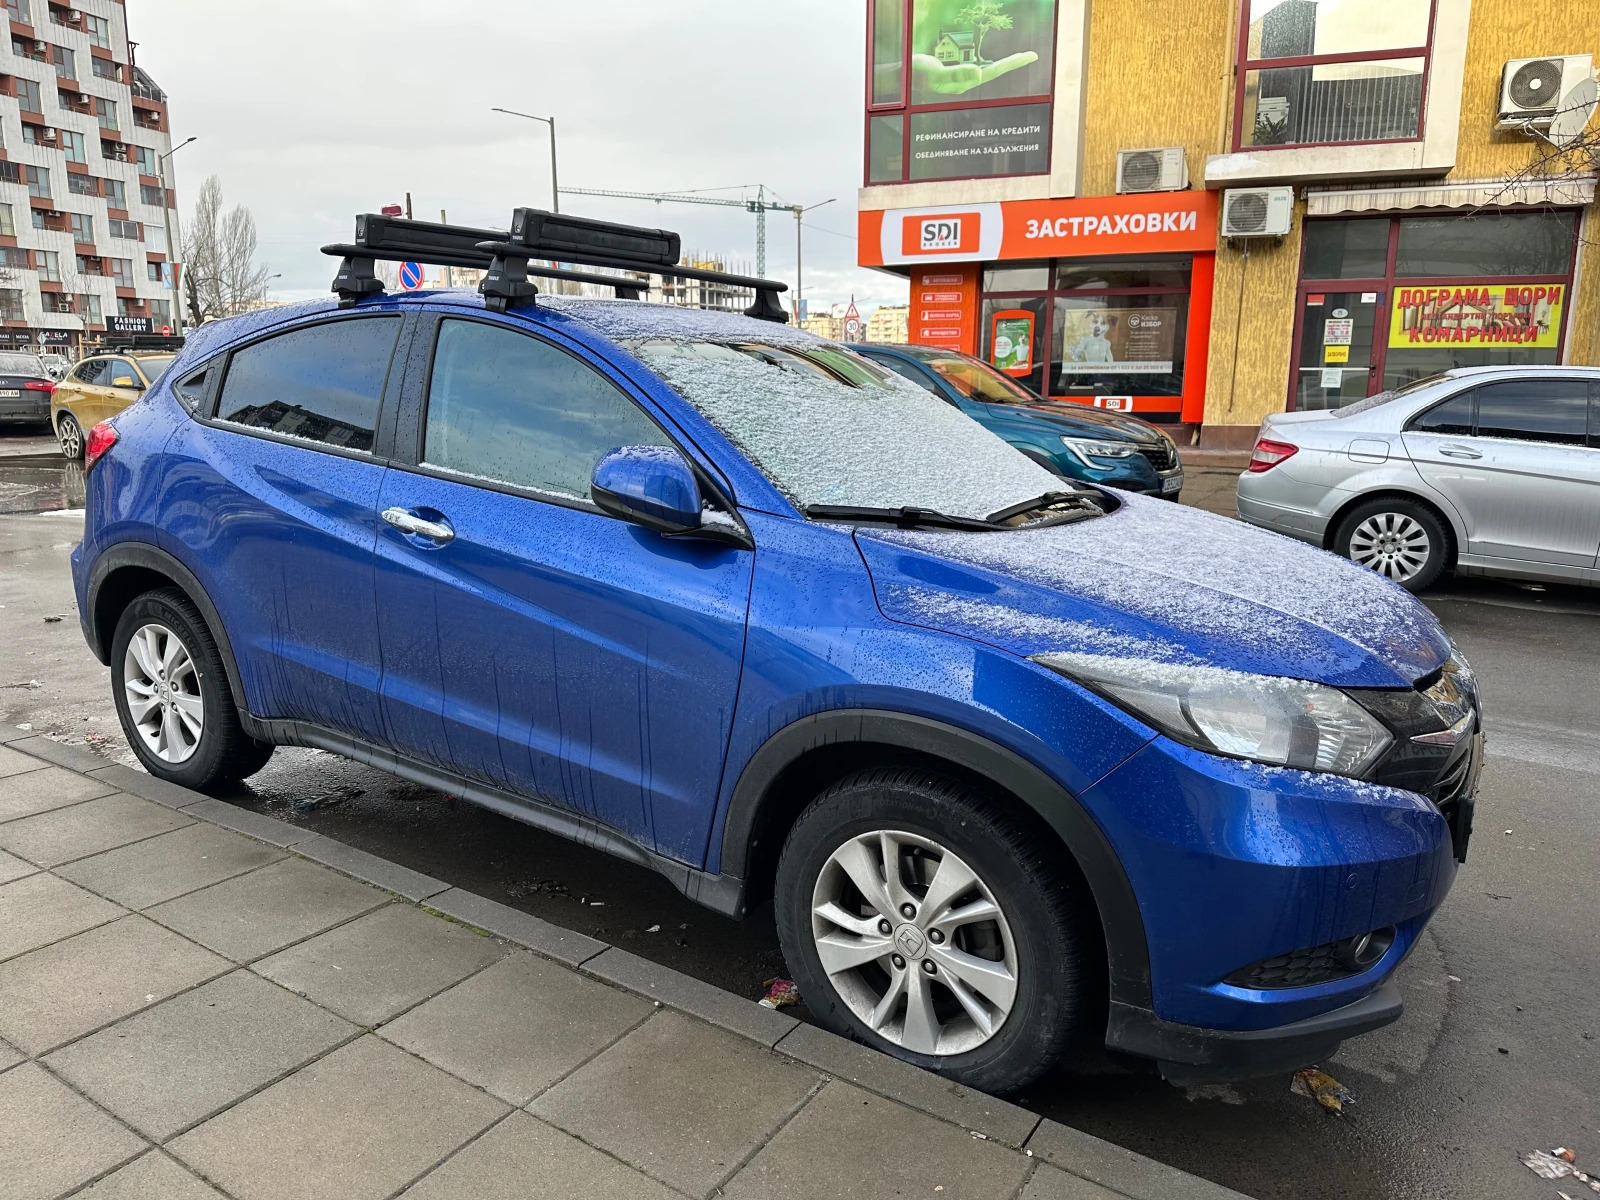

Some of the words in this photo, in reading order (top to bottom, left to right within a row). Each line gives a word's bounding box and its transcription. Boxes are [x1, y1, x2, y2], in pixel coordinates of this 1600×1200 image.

[916, 129, 986, 142] РЕФИНАНСИРАНЕ
[988, 128, 1000, 136] НА
[1002, 126, 1041, 136] КРЕДИТИ
[915, 149, 969, 159] ОБЕДИНЯВАНЕ
[983, 144, 1039, 154] ЗАДЪЛЖЕНИЯ
[924, 222, 958, 242] SDI
[1025, 211, 1197, 239] ЗАСТРАХОВКИ
[1398, 288, 1491, 308] ДОГРАМА
[1504, 287, 1561, 306] ЩОРИ
[115, 324, 147, 332] GALLERY
[848, 322, 857, 331] 30
[1409, 325, 1539, 346] КОМАРНИЦИ
